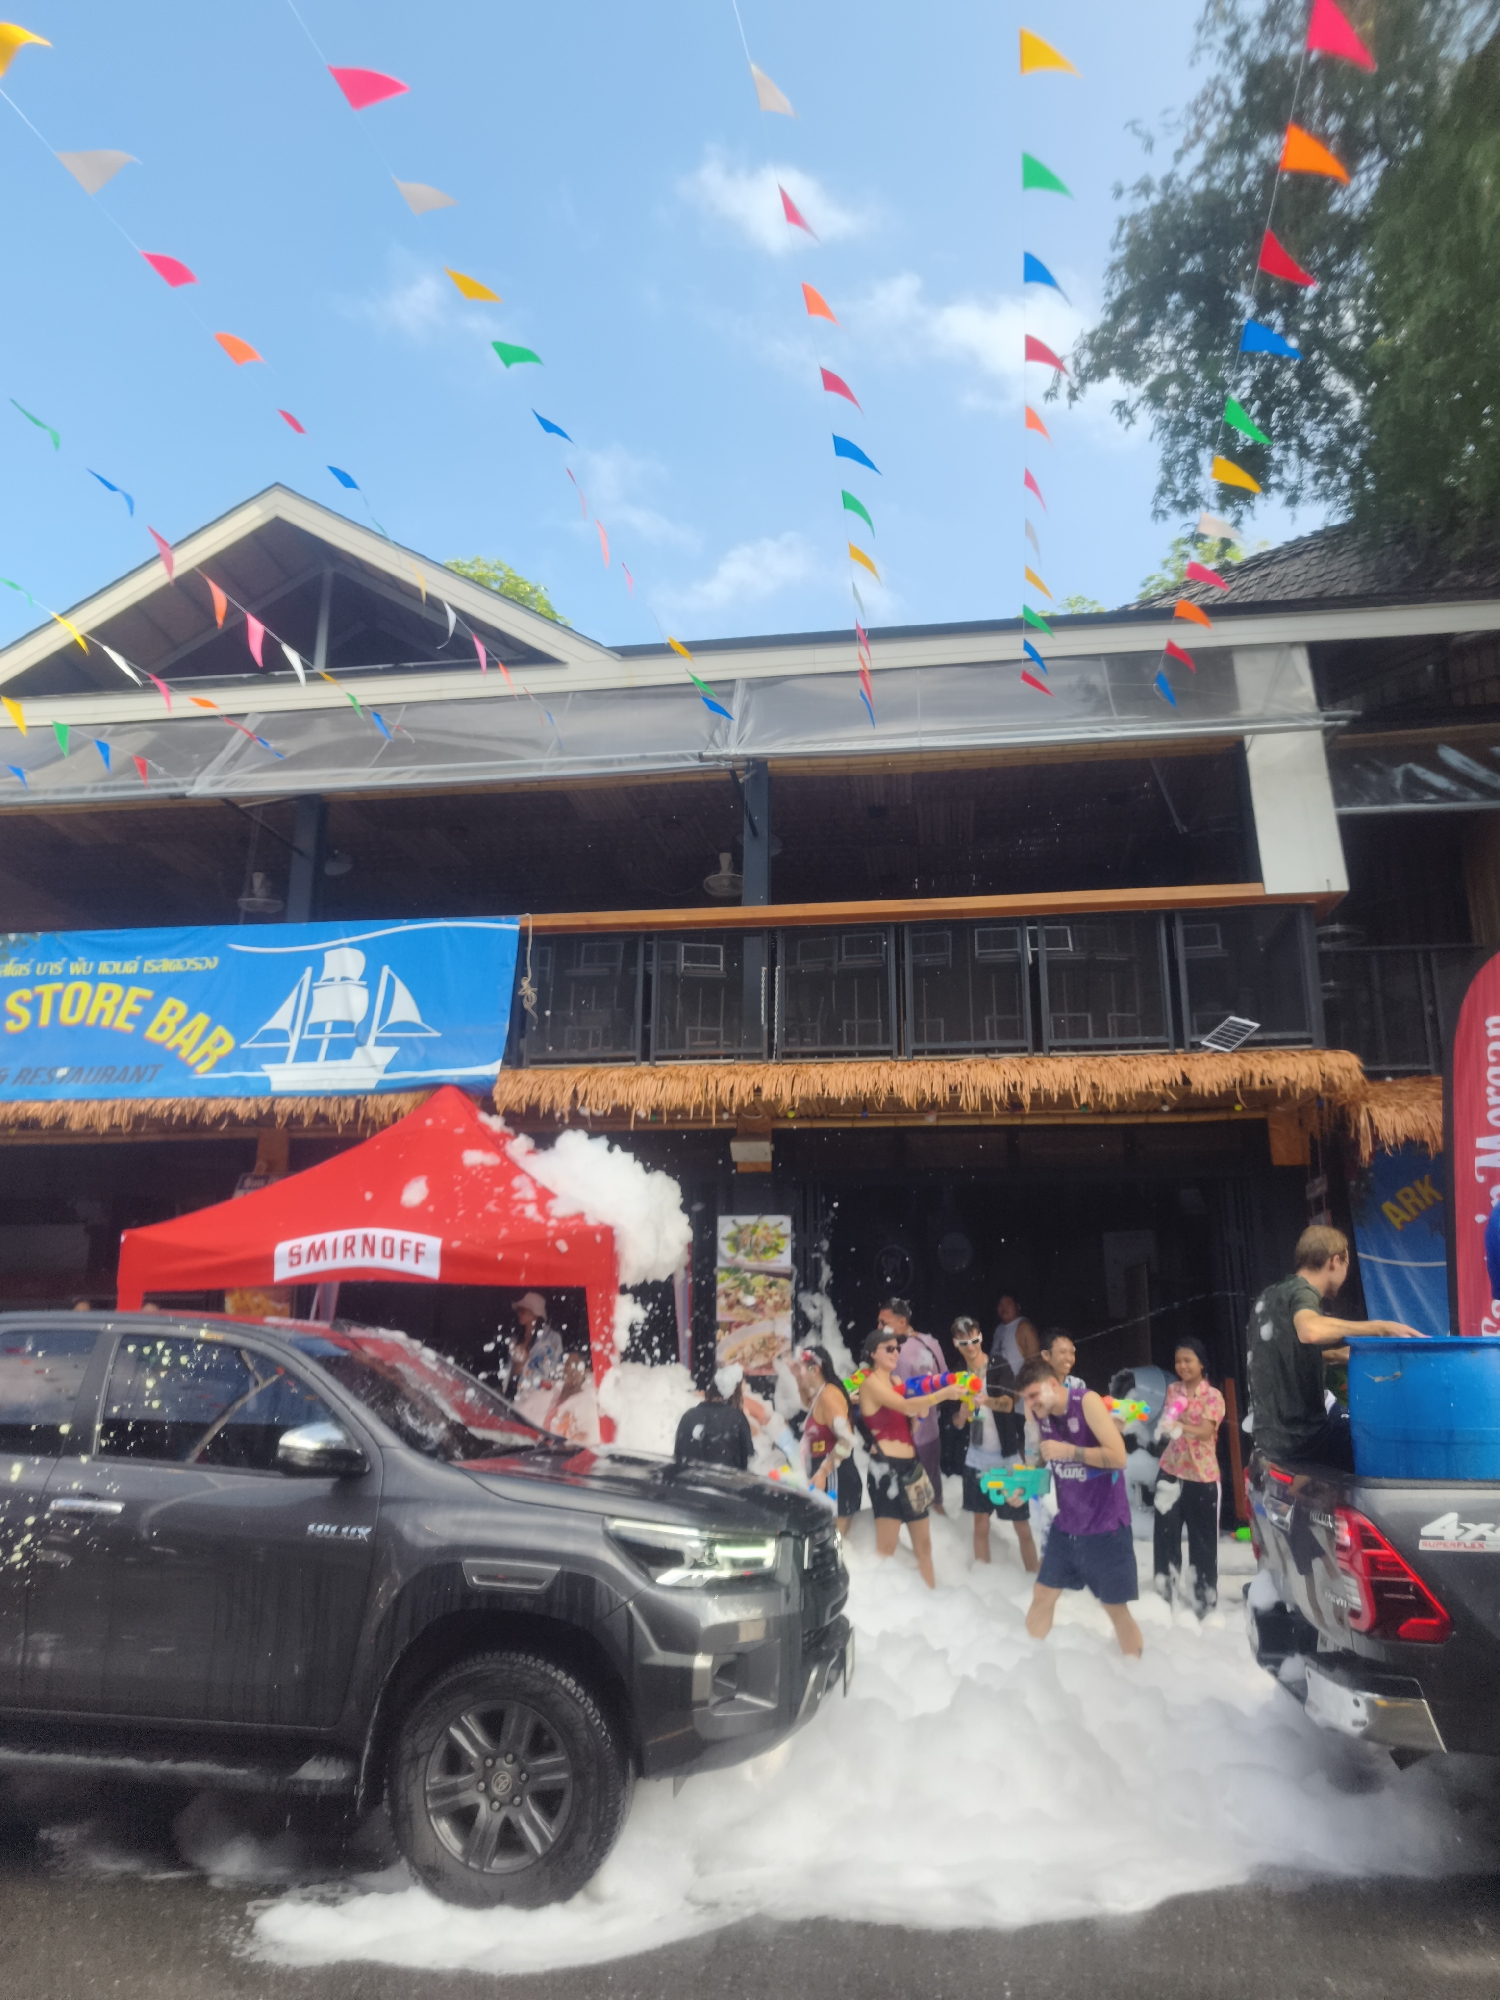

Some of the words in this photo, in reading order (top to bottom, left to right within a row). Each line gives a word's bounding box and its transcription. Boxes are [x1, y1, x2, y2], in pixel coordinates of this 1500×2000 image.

[3, 980, 154, 1034] STORE
[143, 997, 236, 1075] BAR
[1380, 1174, 1444, 1232] ARK
[286, 1233, 427, 1269] SMIRNOFF
[1421, 1511, 1500, 1541] 4x
[1421, 1540, 1486, 1550] SUPERFLEX
